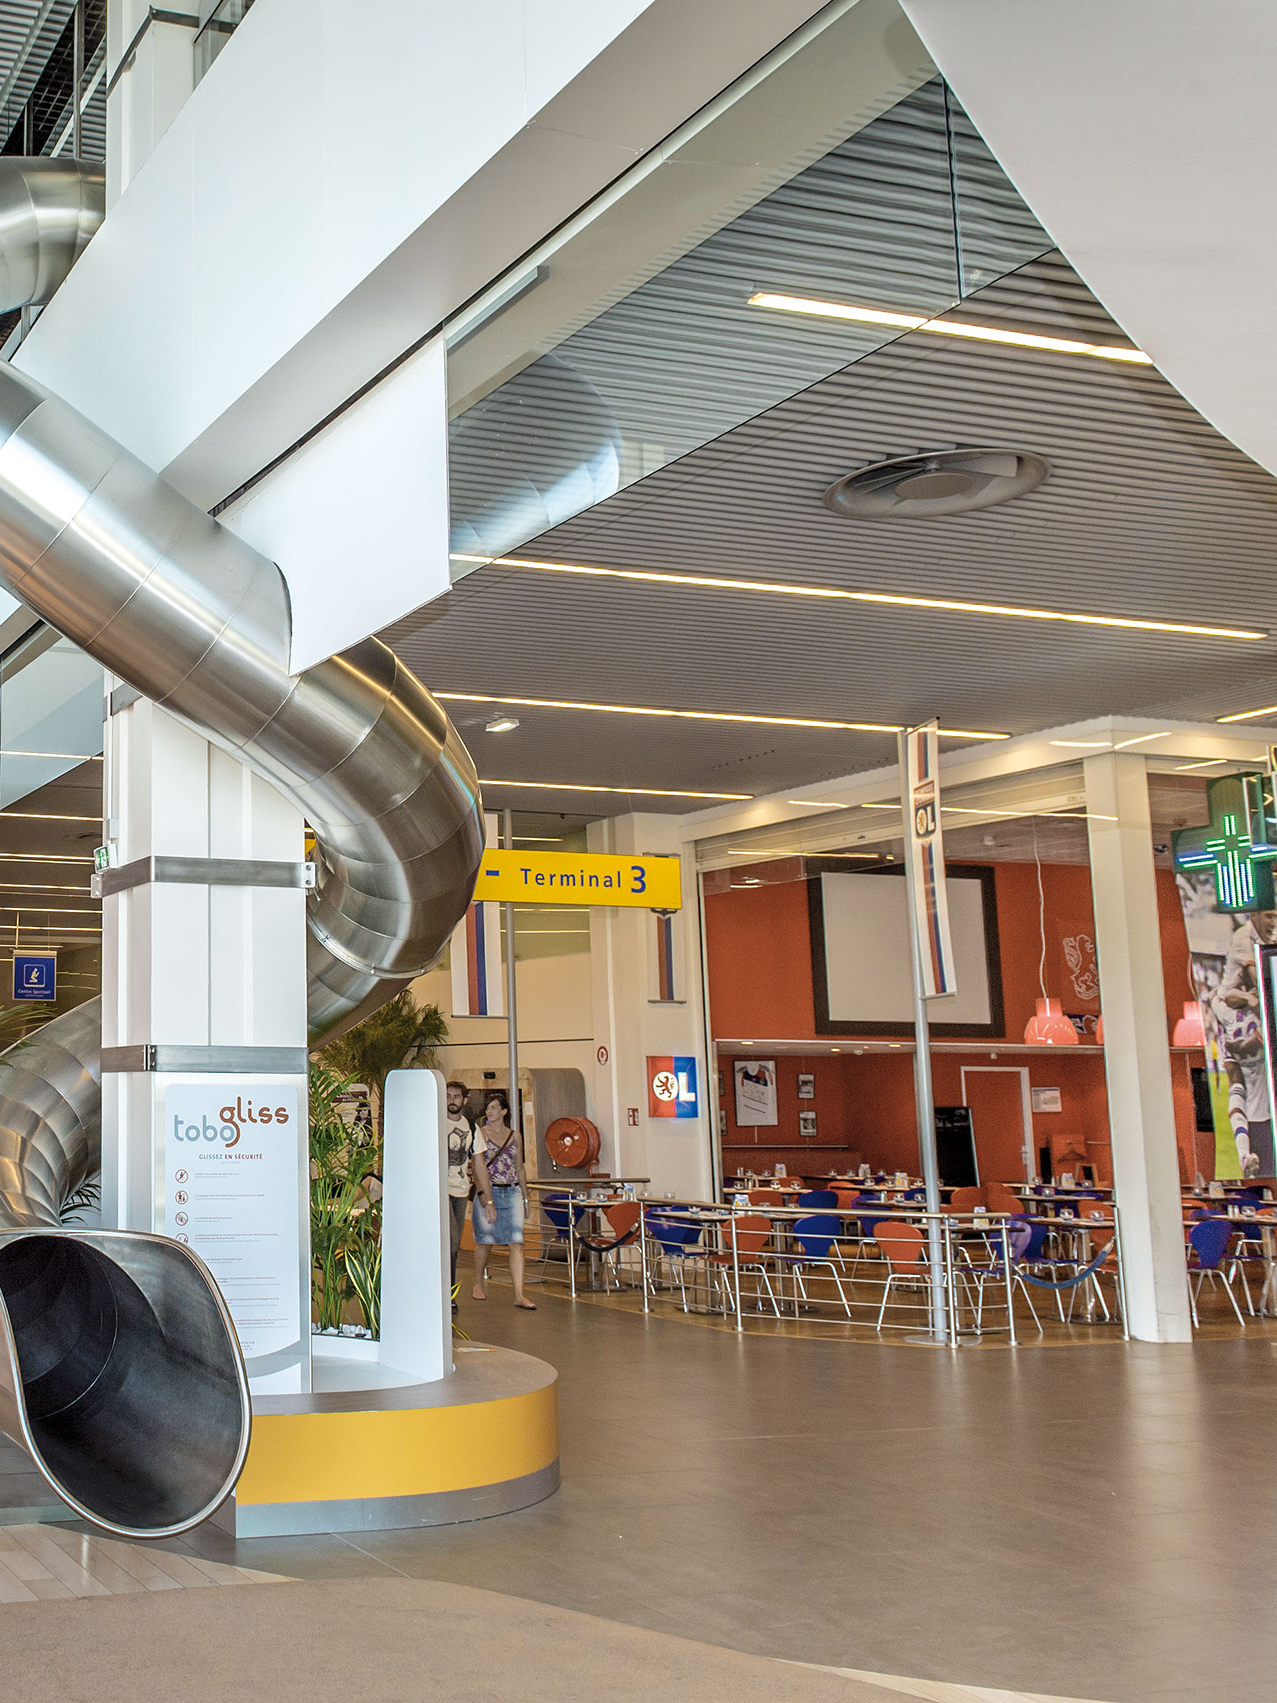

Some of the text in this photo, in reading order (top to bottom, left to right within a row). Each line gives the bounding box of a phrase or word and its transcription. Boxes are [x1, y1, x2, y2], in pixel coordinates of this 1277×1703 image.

[520, 865, 647, 893] Terminal 3
[234, 1152, 263, 1160] SÉCURITÉ
